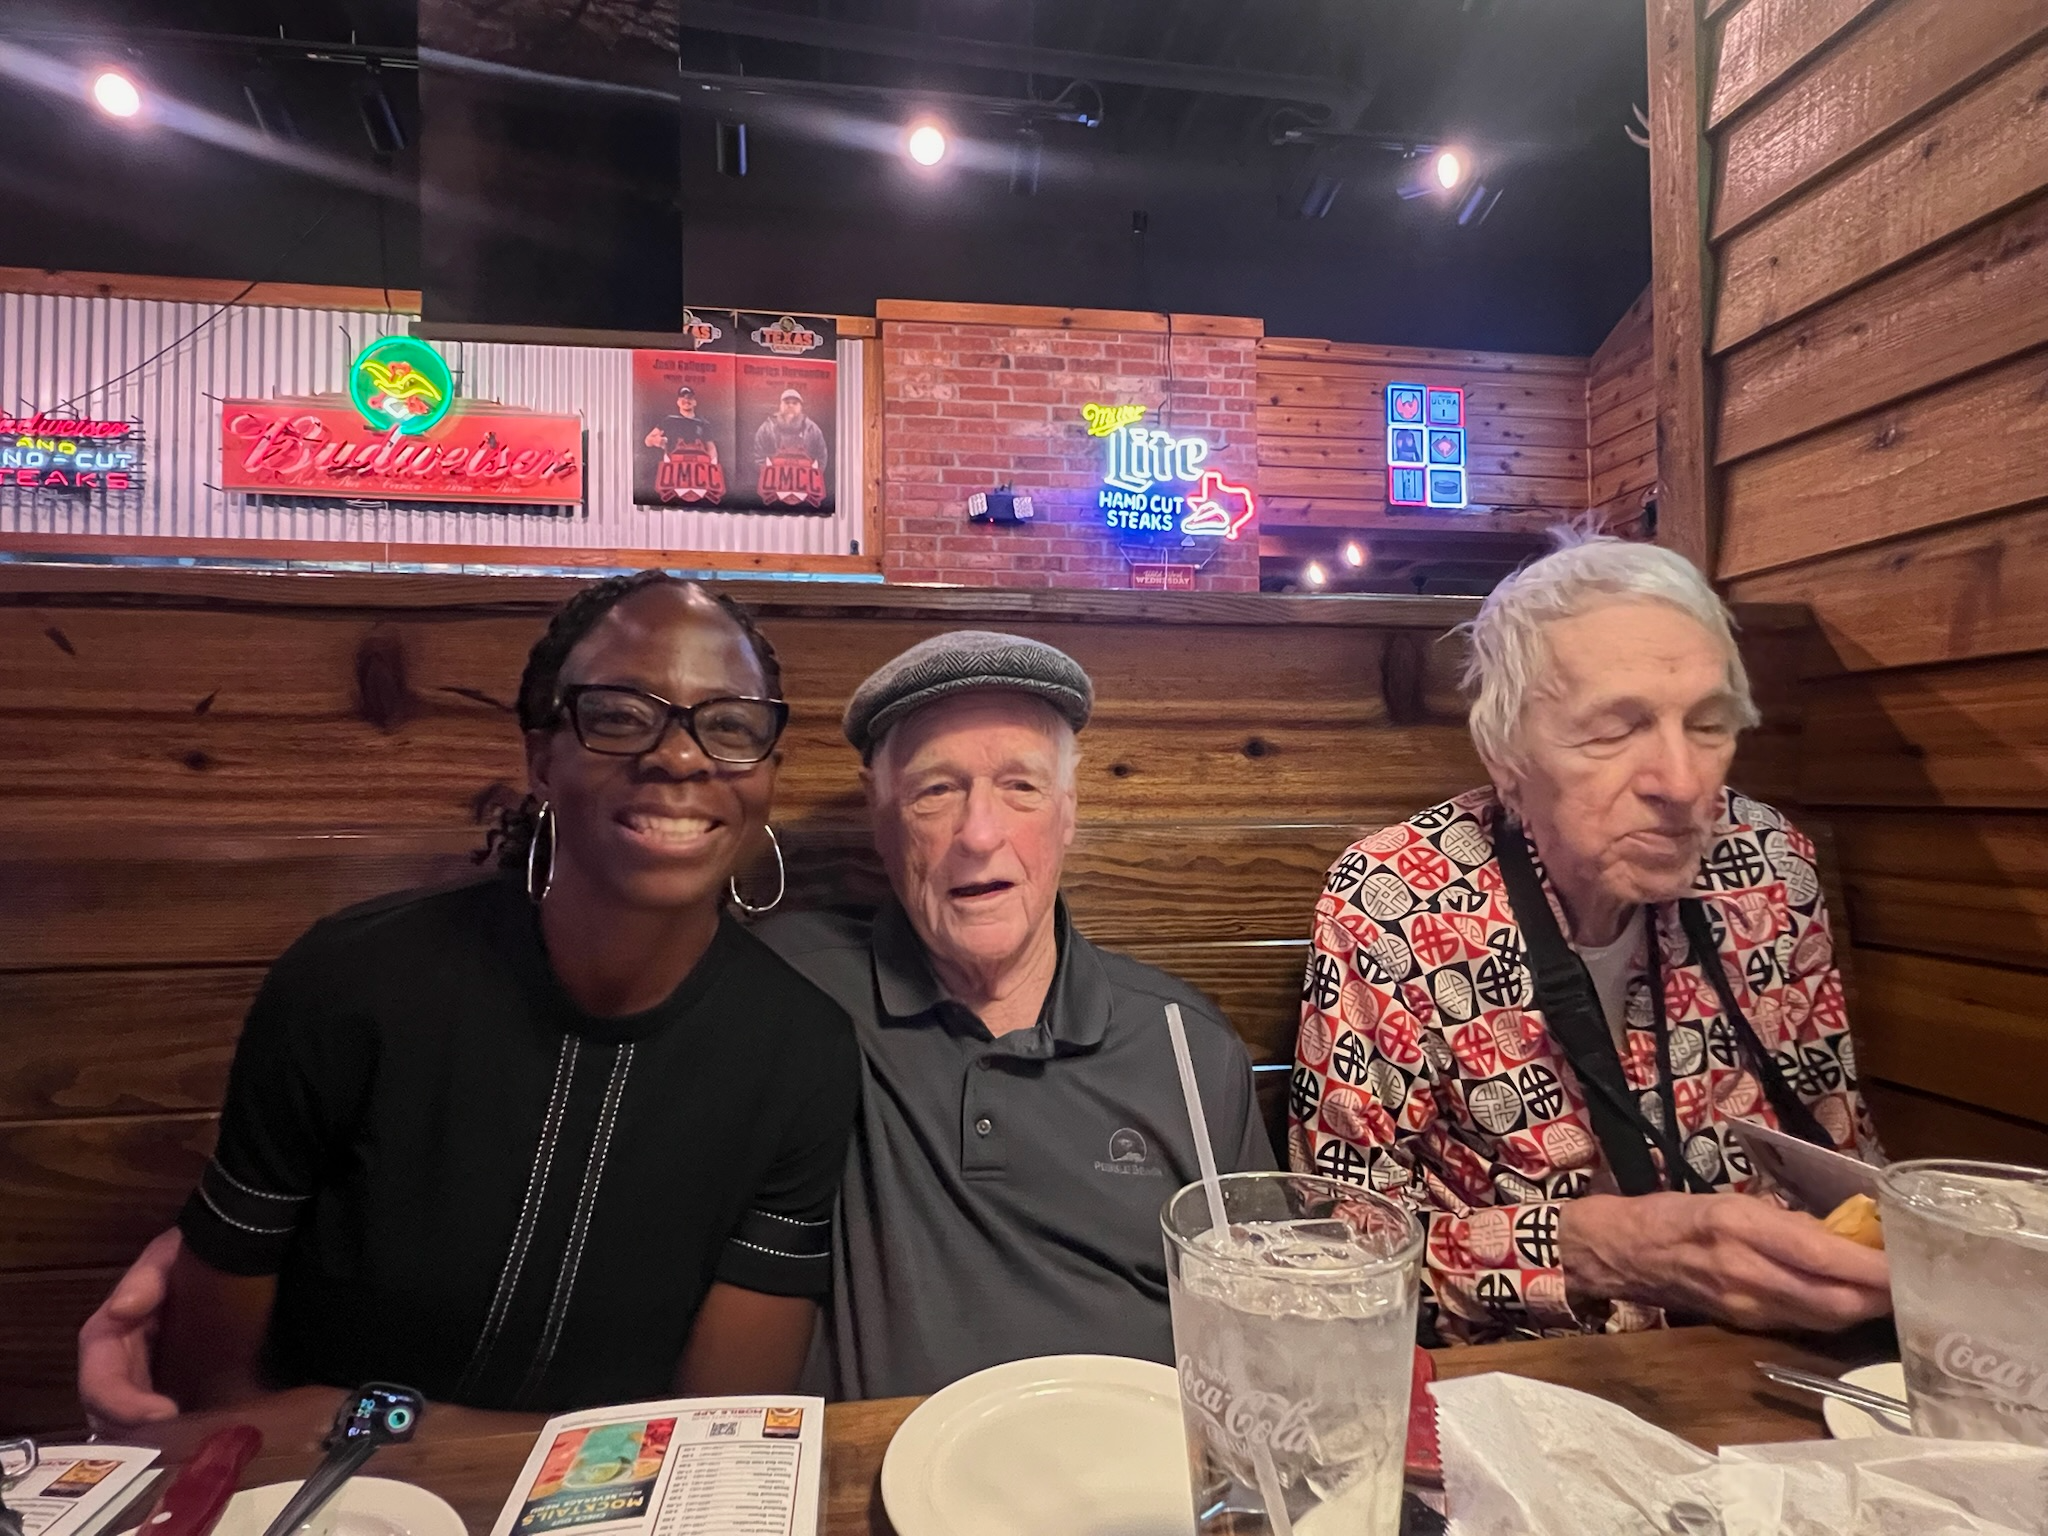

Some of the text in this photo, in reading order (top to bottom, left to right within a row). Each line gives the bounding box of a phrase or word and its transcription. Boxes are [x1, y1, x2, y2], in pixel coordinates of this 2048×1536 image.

[763, 329, 813, 346] TEXAS
[0, 411, 130, 437] udweiser
[16, 436, 77, 455] AND
[228, 413, 577, 480] Budweiser
[2, 449, 132, 468] ND-CUT
[1104, 427, 1208, 493] Lite
[0, 468, 128, 489] TEAKS
[1099, 491, 1184, 514] HAND CUT
[1107, 510, 1173, 531] STEAKS
[521, 1495, 644, 1526] MOCKTAILS
